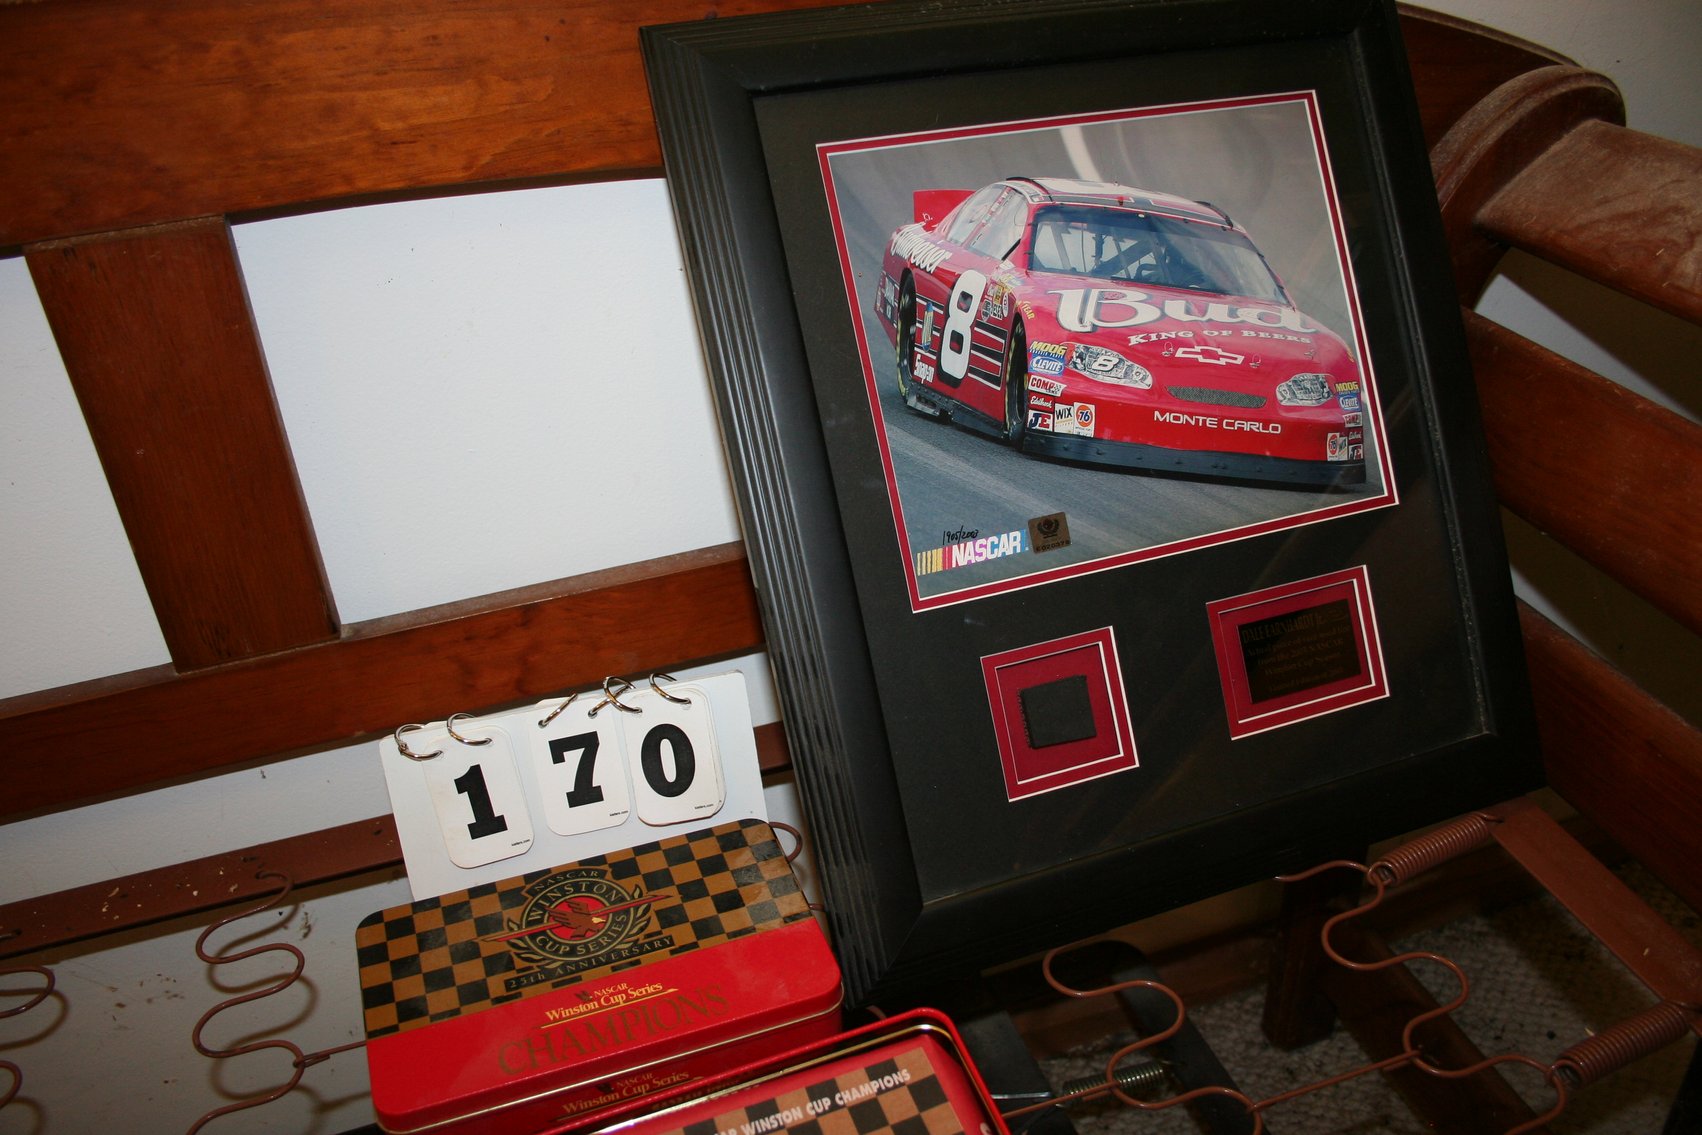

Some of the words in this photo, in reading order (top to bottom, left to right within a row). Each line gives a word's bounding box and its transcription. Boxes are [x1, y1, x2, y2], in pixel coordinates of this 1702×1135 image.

[940, 269, 987, 380] 8
[1047, 287, 1317, 333] Bud
[1029, 341, 1067, 355] MOOG
[1128, 331, 1194, 346] KING
[1241, 331, 1311, 343] BEERS
[1092, 355, 1120, 372] 8
[1031, 377, 1055, 392] COMP
[1335, 381, 1359, 392] MOOG
[1055, 407, 1073, 420] WIX
[1079, 410, 1091, 422] 76
[1154, 411, 1218, 427] MONTE
[1222, 419, 1281, 434] CARLO
[952, 531, 1021, 568] NASCAR
[454, 764, 508, 840] 1
[549, 731, 604, 808] 7
[641, 724, 696, 797] 0
[535, 871, 599, 891] NASCAR
[528, 881, 621, 921] WINSTON
[536, 935, 570, 955] CUP
[576, 913, 627, 955] SERIES
[509, 973, 545, 989] 25th
[555, 936, 673, 976] ANNIVERSARY
[545, 999, 599, 1022] Winston
[600, 992, 626, 1008] Cup
[627, 981, 663, 999] Series
[594, 982, 628, 998] NASCAR
[498, 983, 728, 1076] CHAMPIONS
[562, 1090, 620, 1115] Winston
[622, 1082, 650, 1098] Cup
[652, 1071, 690, 1087] Series
[616, 1072, 654, 1089] NASCAR
[741, 1105, 804, 1135] WINSTON
[805, 1097, 832, 1116] CUP
[834, 1068, 911, 1106] CHAMPIONS
